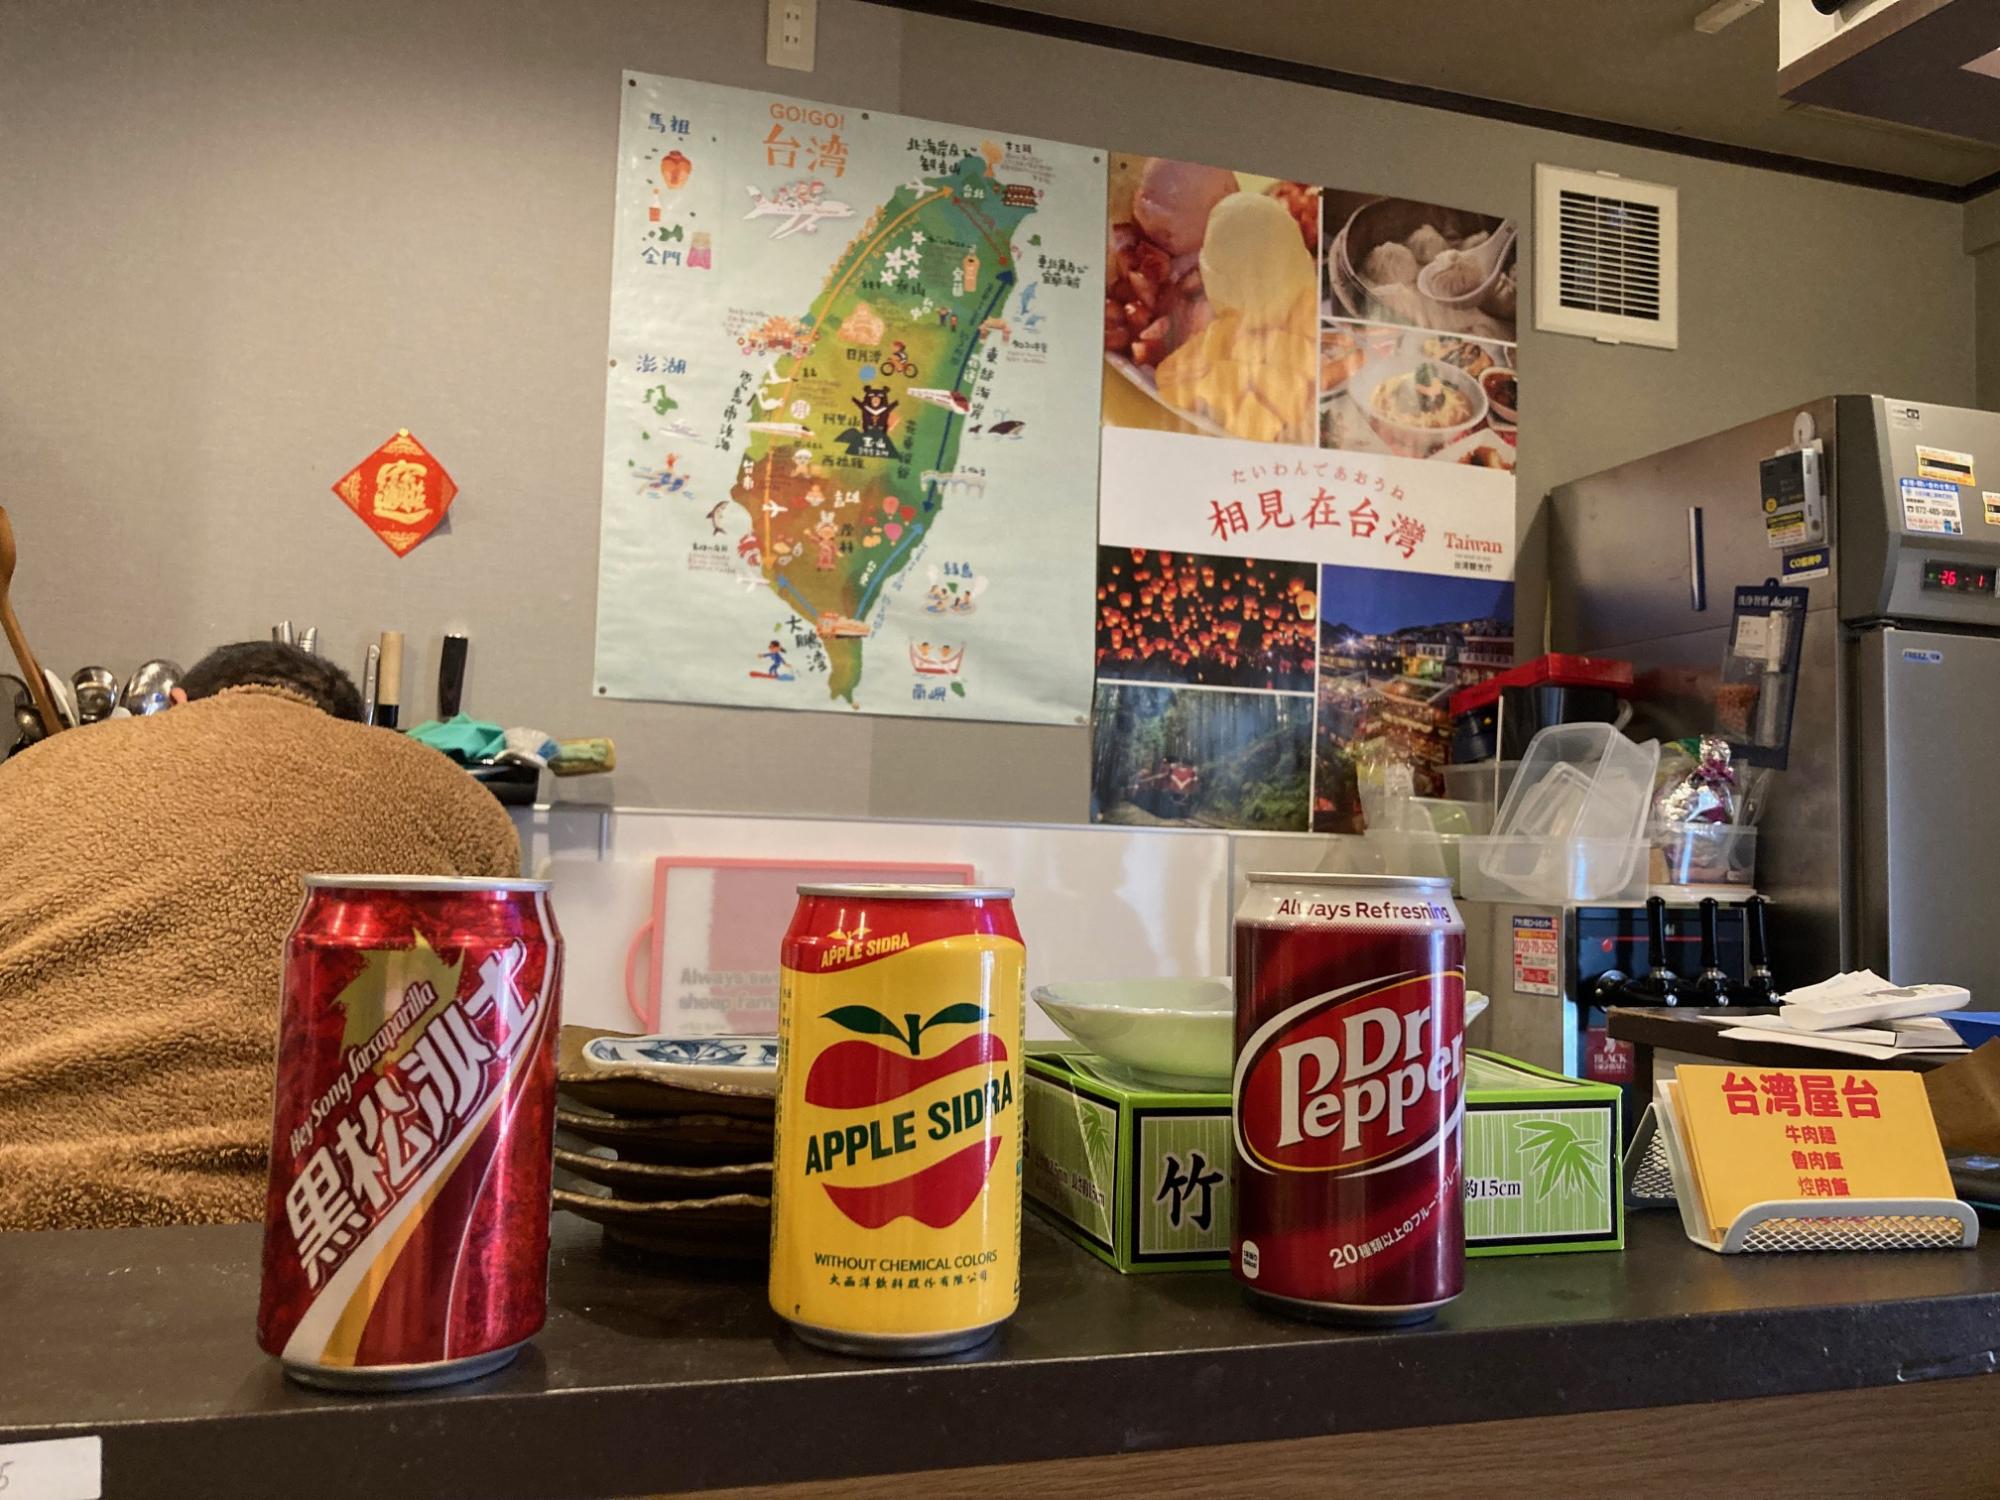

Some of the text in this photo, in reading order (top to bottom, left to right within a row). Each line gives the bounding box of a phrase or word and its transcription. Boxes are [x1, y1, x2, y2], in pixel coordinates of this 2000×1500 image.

[648, 112, 690, 134] 馬祖
[769, 103, 845, 129] GO!GO!
[762, 123, 850, 178] 台湾
[641, 246, 681, 266] 金門
[636, 353, 687, 375] 澎湖
[1232, 461, 1405, 501] たいわんであおうね
[1207, 486, 1427, 560] 相見在台灣
[1444, 532, 1503, 554] Taiwan
[1355, 901, 1452, 923] Refreshing
[821, 932, 911, 968] APPLE SIDRA
[1342, 1006, 1431, 1081] Dr
[289, 981, 436, 1158] Hey Song Sarsaparilla
[1277, 1031, 1464, 1152] Pepper
[1721, 1071, 1883, 1119] 台湾屋台
[805, 1110, 917, 1176] APPLE
[927, 1072, 1013, 1141] SIDRA
[1791, 1150, 1844, 1171] 魯肉飯
[1155, 1152, 1224, 1231] 竹
[1465, 1178, 1521, 1199] 約15cm
[814, 1250, 998, 1272] WITHOUT CHEMICAL COLORS
